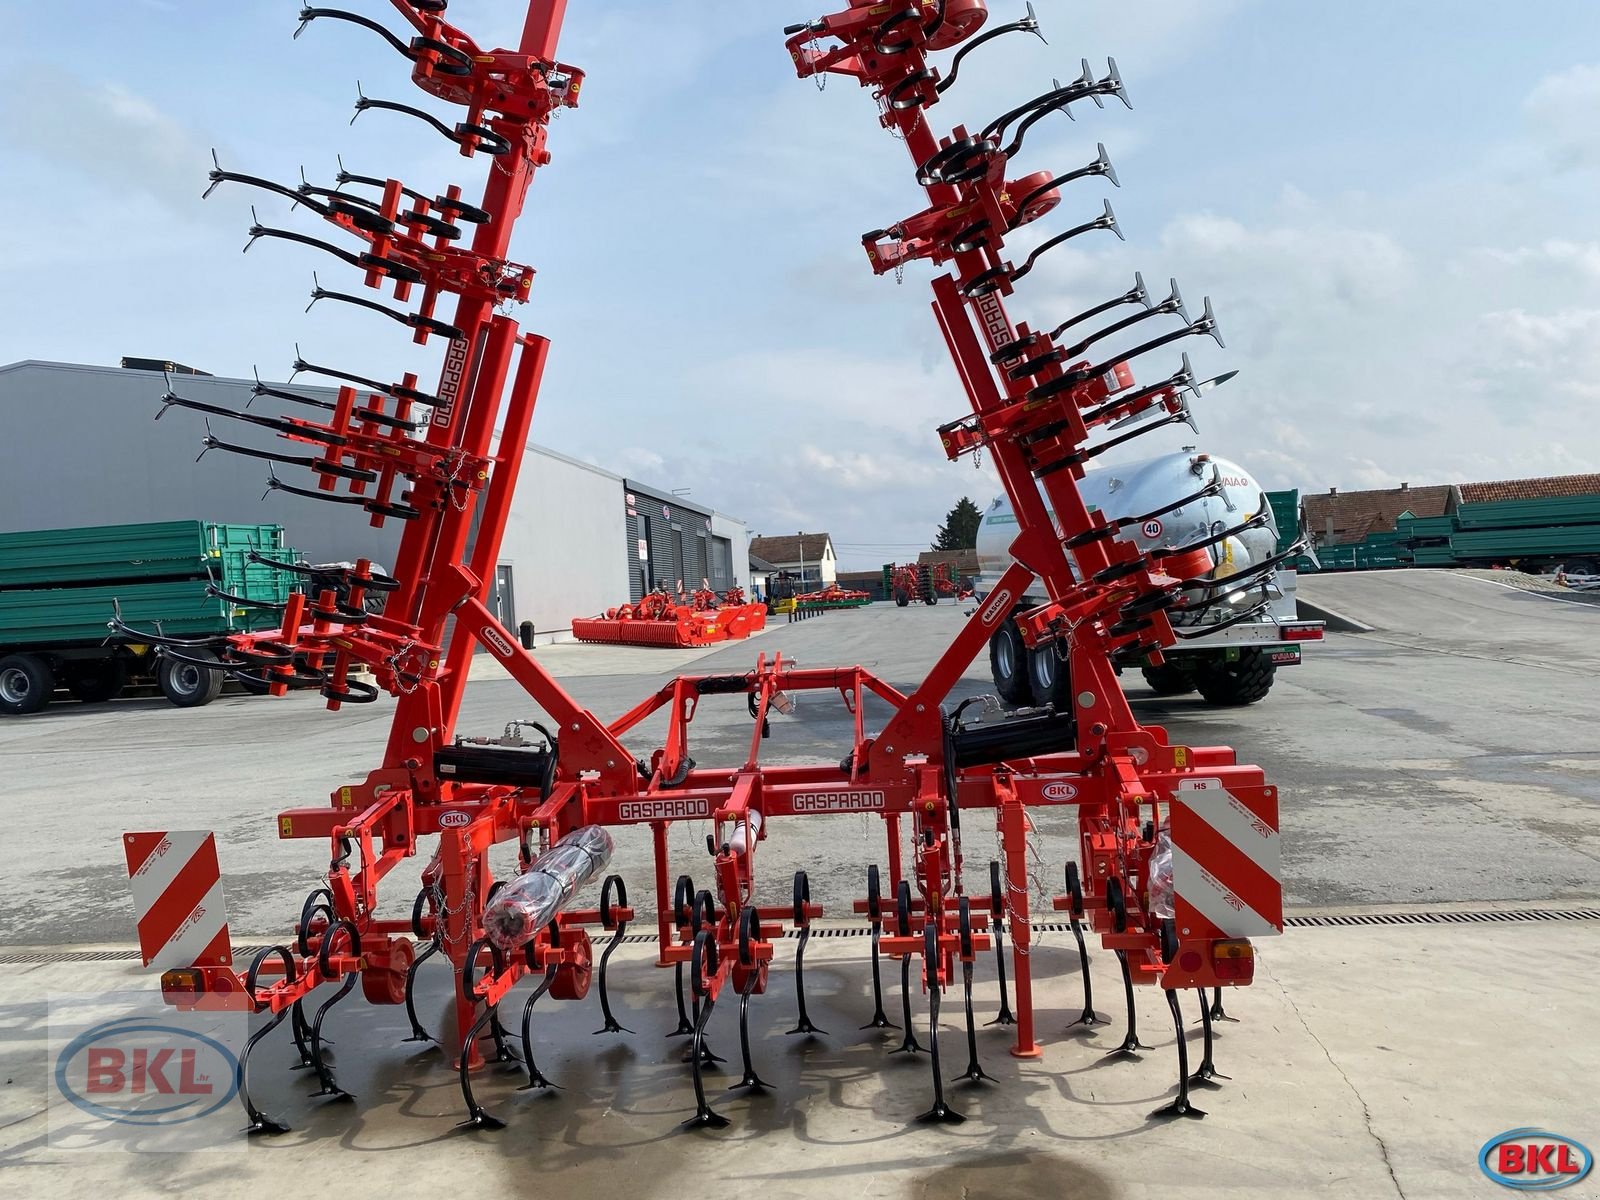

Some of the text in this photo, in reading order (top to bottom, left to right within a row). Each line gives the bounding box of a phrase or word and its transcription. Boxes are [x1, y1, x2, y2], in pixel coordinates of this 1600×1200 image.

[1146, 523, 1159, 533] 40
[984, 592, 1008, 620] MASCHIO
[486, 628, 511, 655] MASCHIO
[1049, 786, 1073, 795] BKL
[1193, 782, 1207, 790] HS
[794, 792, 884, 810] GASPARDO
[620, 800, 708, 818] GASPARDO
[445, 814, 467, 823] BKL
